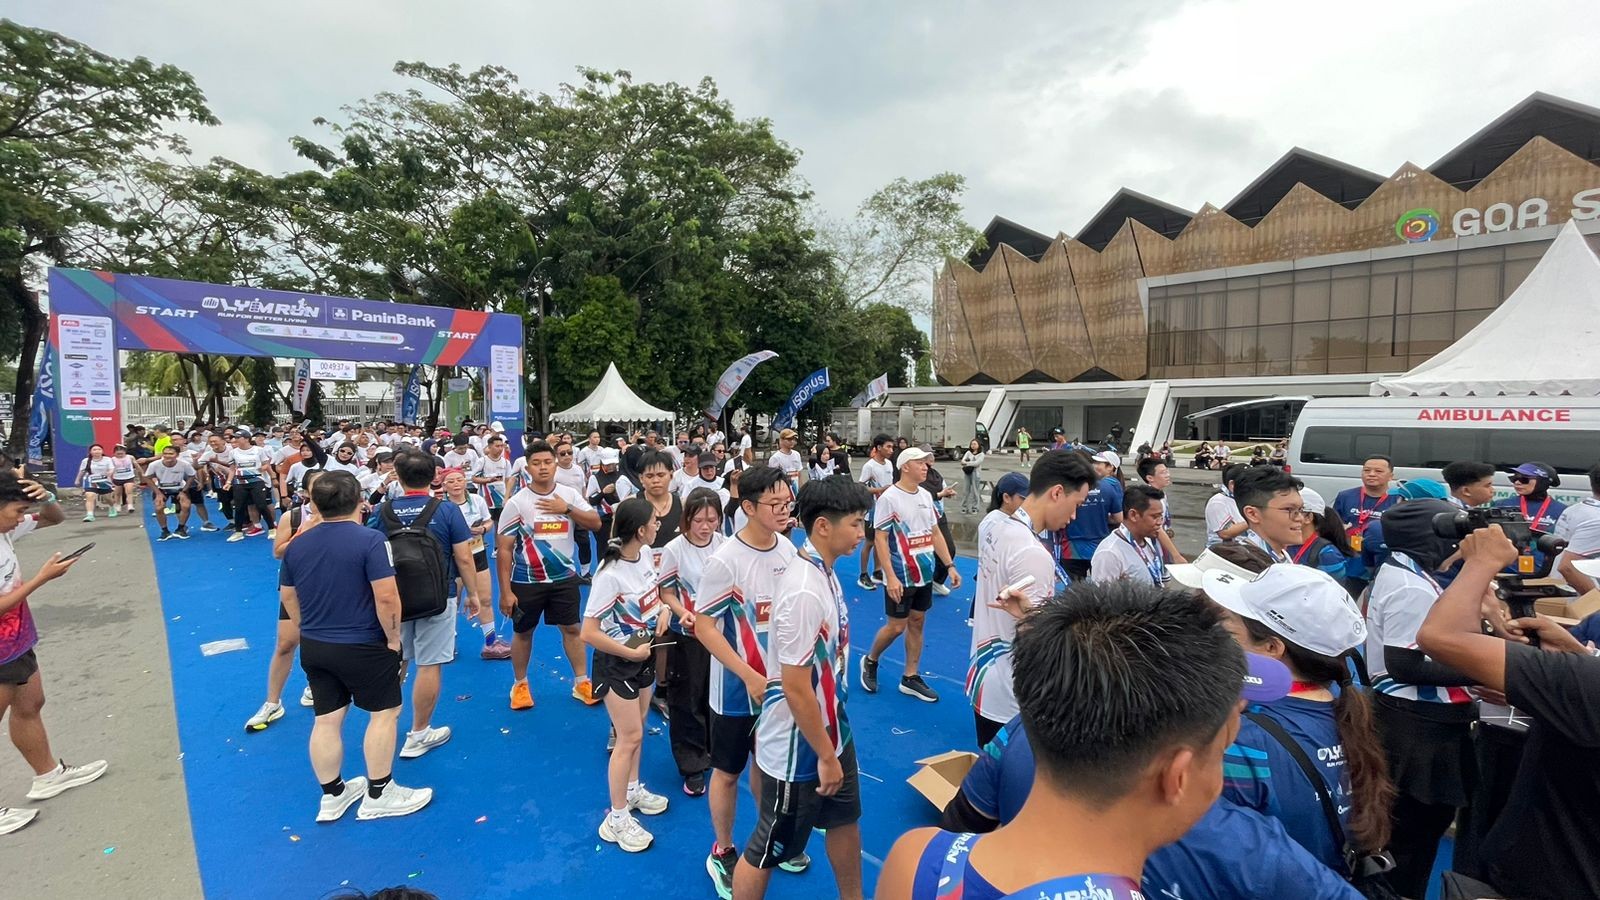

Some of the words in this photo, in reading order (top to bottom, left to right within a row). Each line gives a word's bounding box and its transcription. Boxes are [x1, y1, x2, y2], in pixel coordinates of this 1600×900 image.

[1452, 197, 1549, 237] GOR
[135, 305, 200, 319] START
[351, 309, 436, 328] PaninBank
[437, 330, 478, 341] START
[1417, 409, 1571, 422] AMBULANCE
